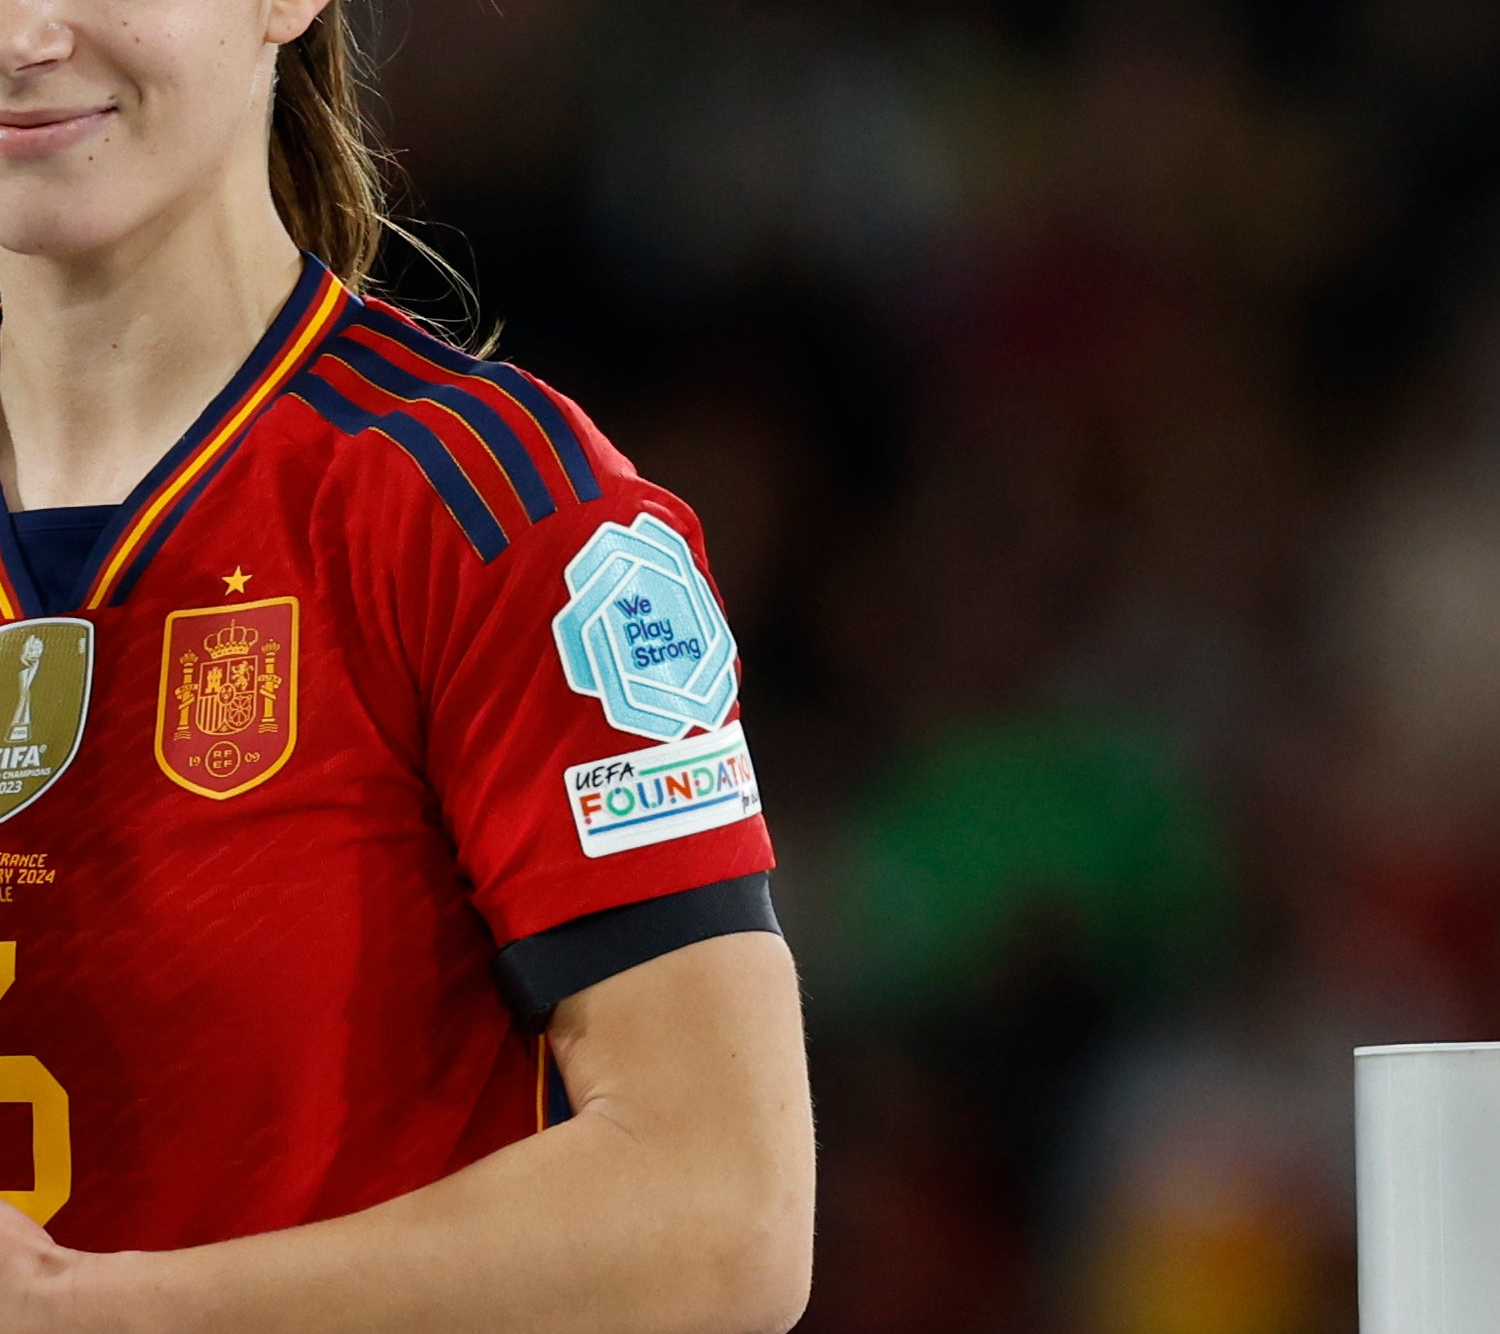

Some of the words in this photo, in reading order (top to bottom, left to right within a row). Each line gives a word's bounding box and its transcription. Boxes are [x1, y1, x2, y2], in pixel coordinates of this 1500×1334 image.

[616, 595, 652, 617] We
[626, 619, 674, 644] Play
[634, 638, 701, 667] Strong
[2, 767, 52, 780] CHAMPIONS
[576, 762, 635, 791] UEFA
[17, 869, 56, 884] 2024
